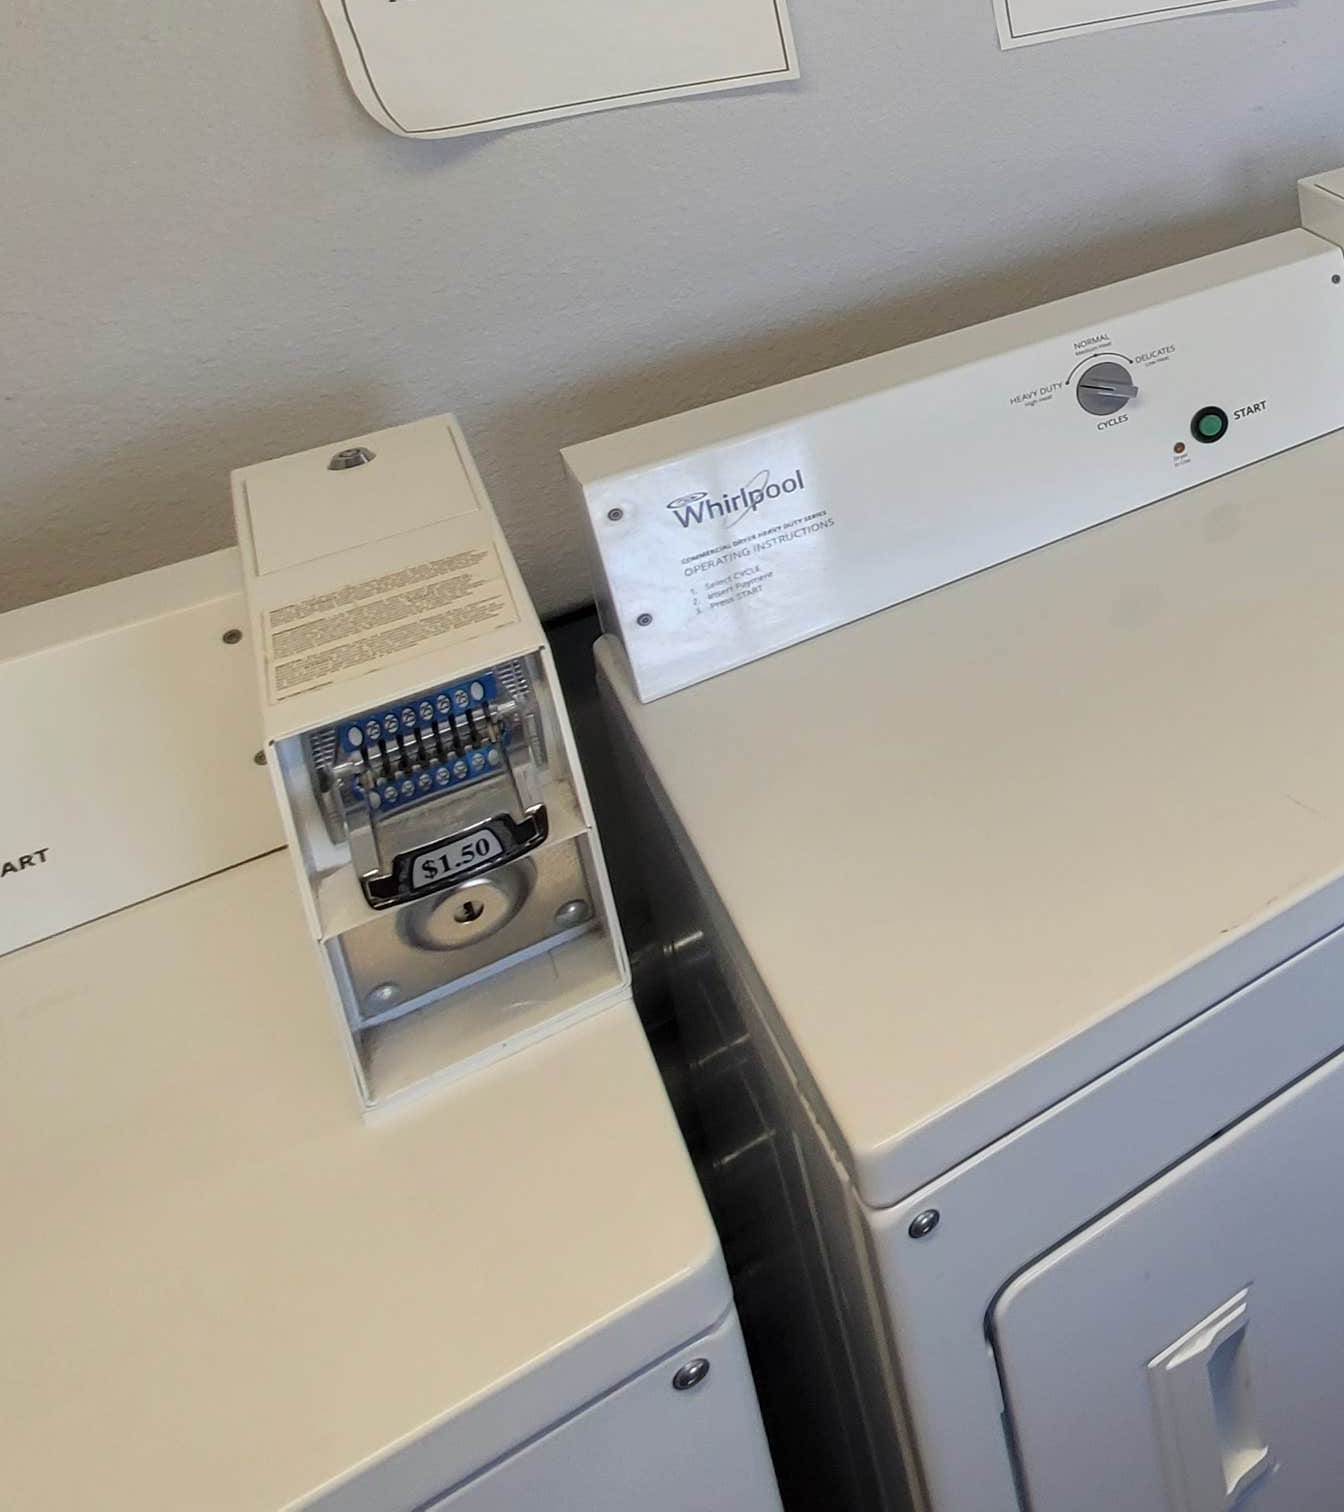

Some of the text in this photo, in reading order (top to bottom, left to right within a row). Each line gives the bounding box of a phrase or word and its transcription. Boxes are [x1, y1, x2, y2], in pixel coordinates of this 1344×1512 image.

[1074, 333, 1110, 350] NORMAL
[1135, 344, 1176, 364] DELICATES
[1009, 382, 1062, 405] HEAVY DUTY
[1233, 400, 1267, 420] START
[1097, 413, 1129, 431] CYCLES
[674, 470, 804, 528] Whirlpool
[783, 518, 802, 530] DUTY
[684, 518, 835, 577] OPERATING INSTRUCTIONS
[0, 848, 49, 877] ART
[421, 838, 491, 880] $1.50
